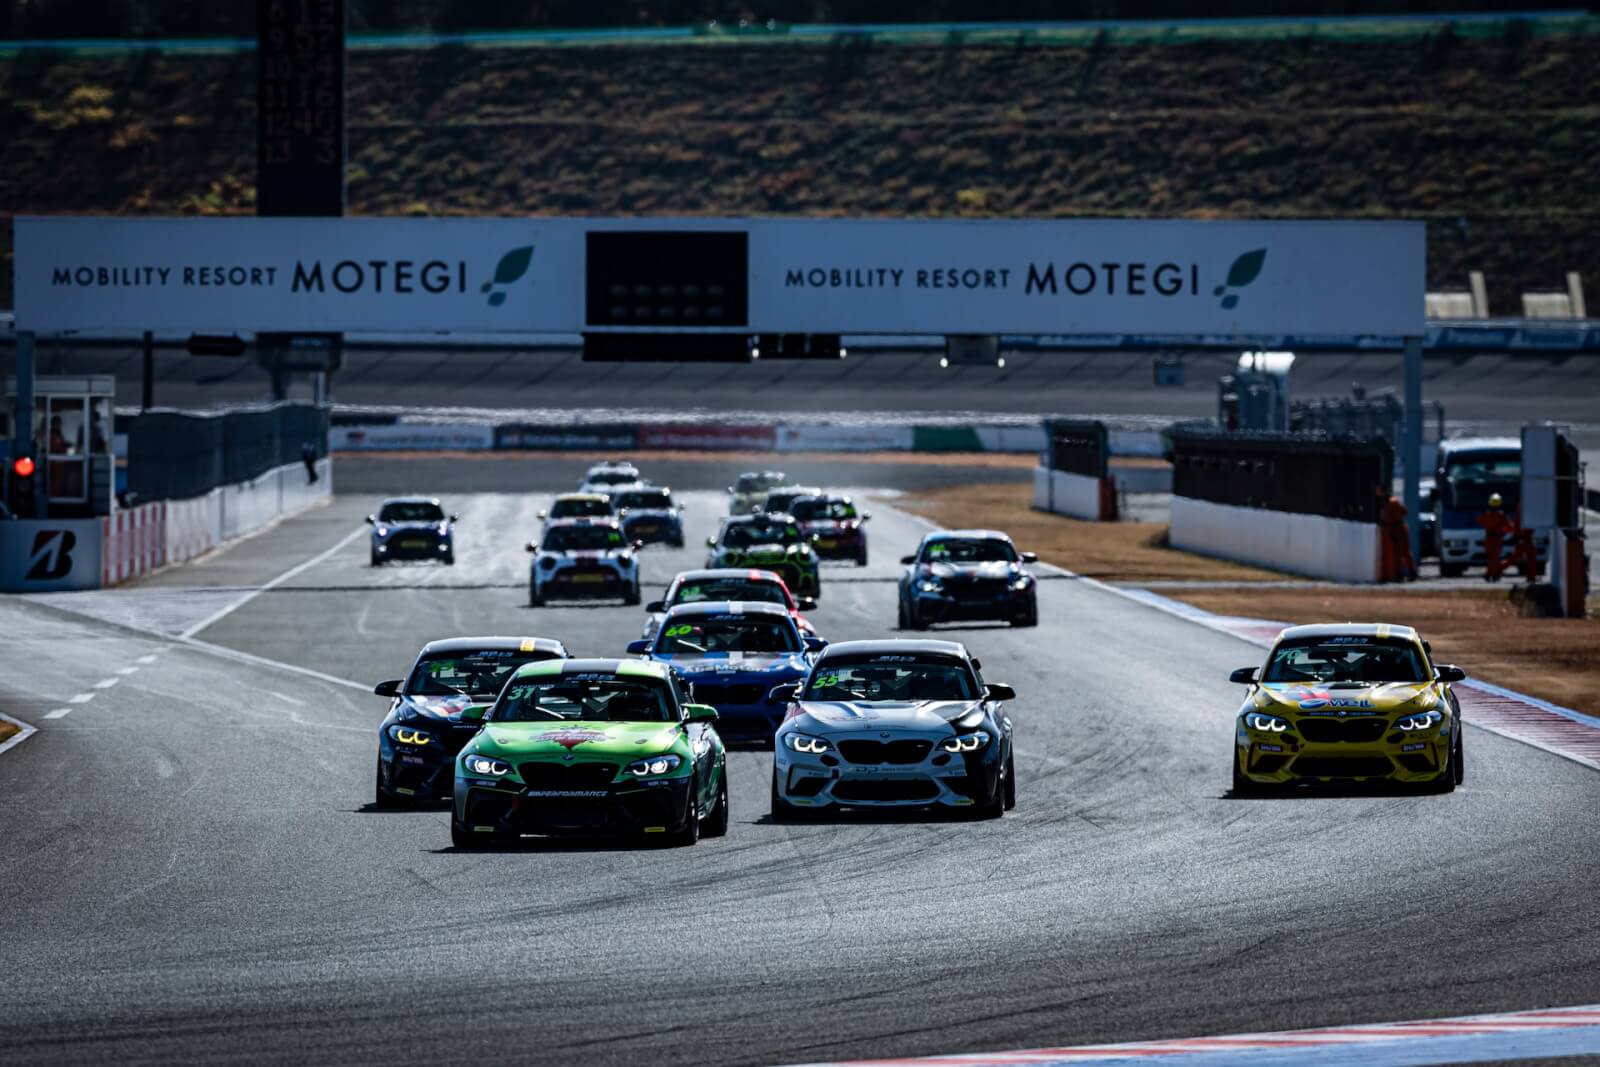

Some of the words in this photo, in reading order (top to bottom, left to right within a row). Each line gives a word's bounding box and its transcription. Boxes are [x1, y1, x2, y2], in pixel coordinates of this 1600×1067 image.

[52, 266, 171, 287] MOBILITY
[183, 266, 276, 286] RESORT
[292, 260, 466, 294] MOTEGI
[785, 267, 904, 288] MOBILITY
[917, 268, 1010, 289] RESORT
[1025, 262, 1199, 296] MOTEGI
[665, 624, 693, 638] 60
[811, 675, 839, 689] 55
